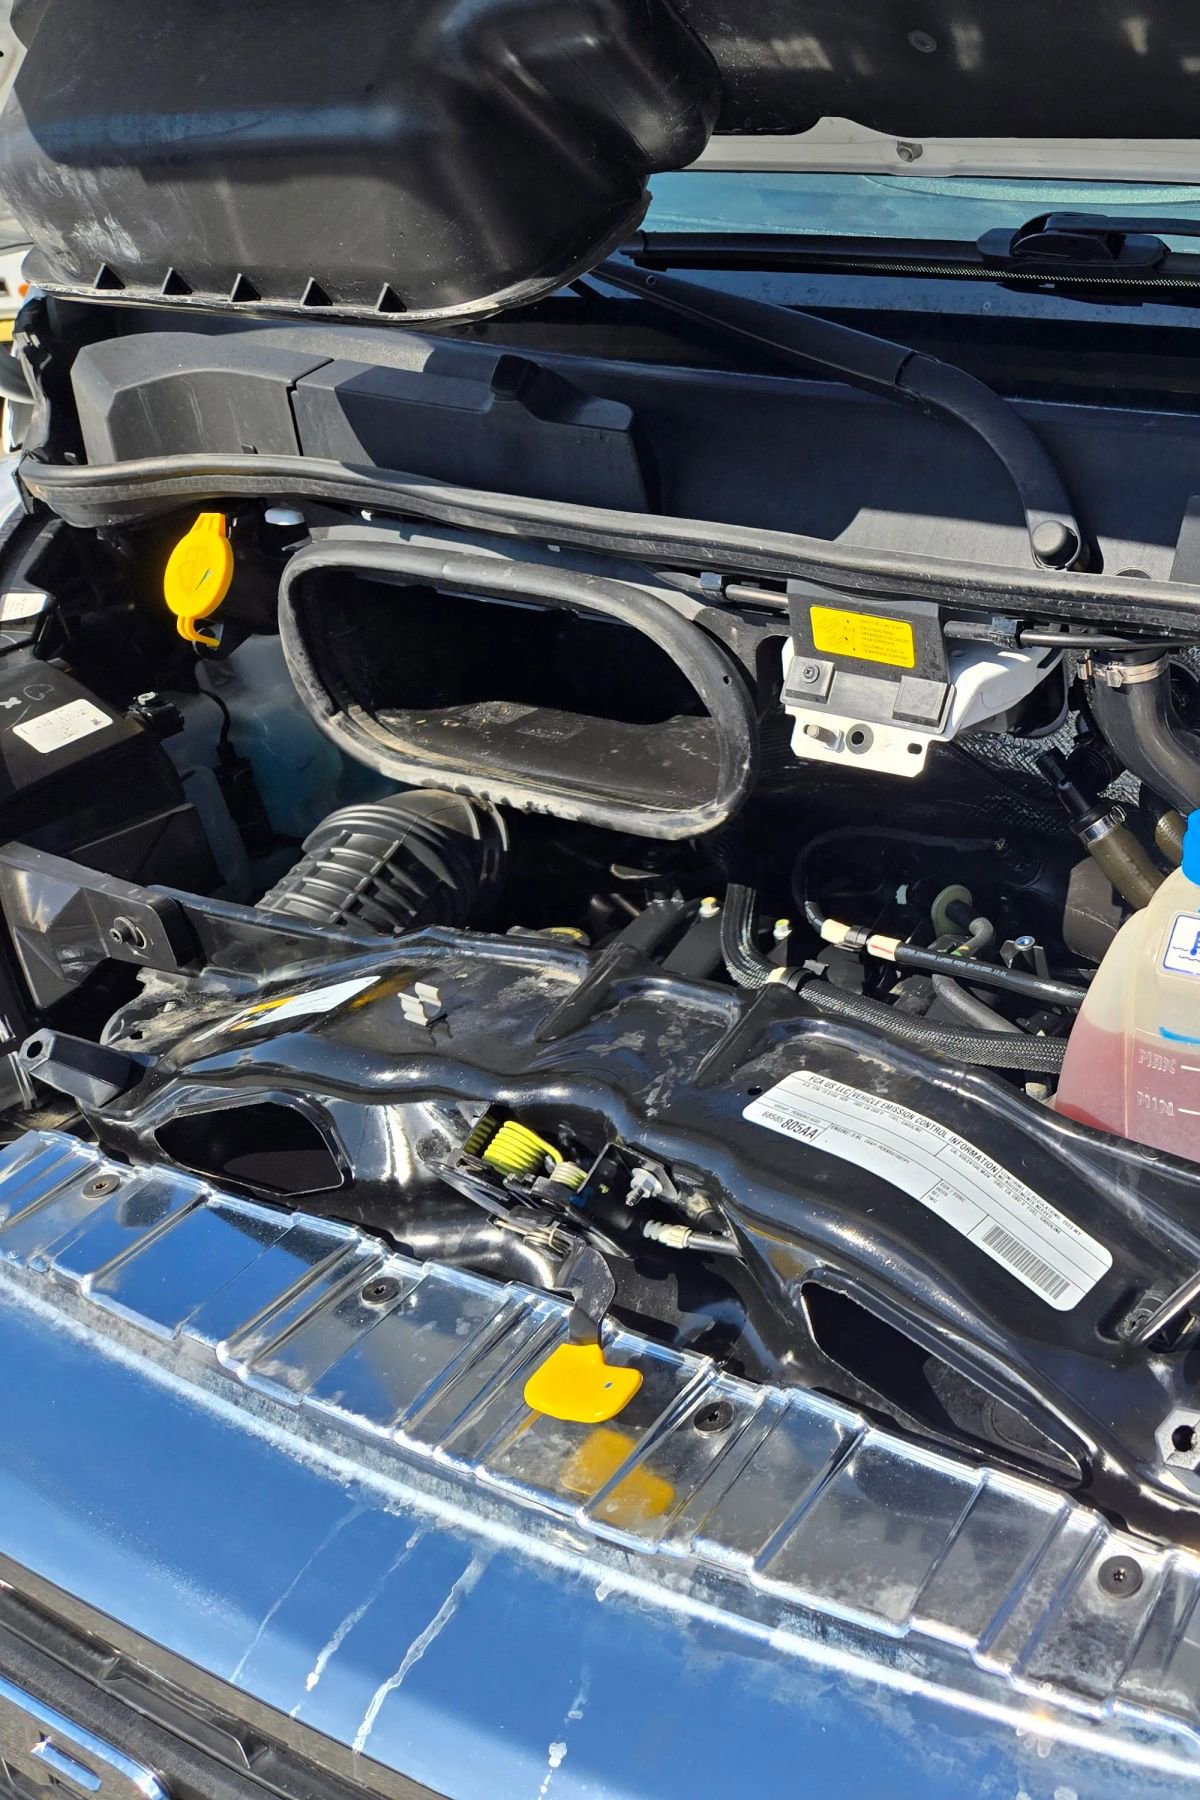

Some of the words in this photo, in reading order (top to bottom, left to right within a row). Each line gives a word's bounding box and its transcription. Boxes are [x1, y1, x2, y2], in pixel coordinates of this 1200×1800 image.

[1136, 1048, 1176, 1075] MAX
[808, 1075, 825, 1085] FCA
[823, 1079, 837, 1089] US
[835, 1083, 852, 1096] LLC
[1136, 1090, 1174, 1117] MIN
[851, 1091, 881, 1107] VEHICLE
[880, 1102, 916, 1121] EMISSION
[914, 1116, 948, 1139] CONTROL
[948, 1135, 999, 1173] INFORMATION
